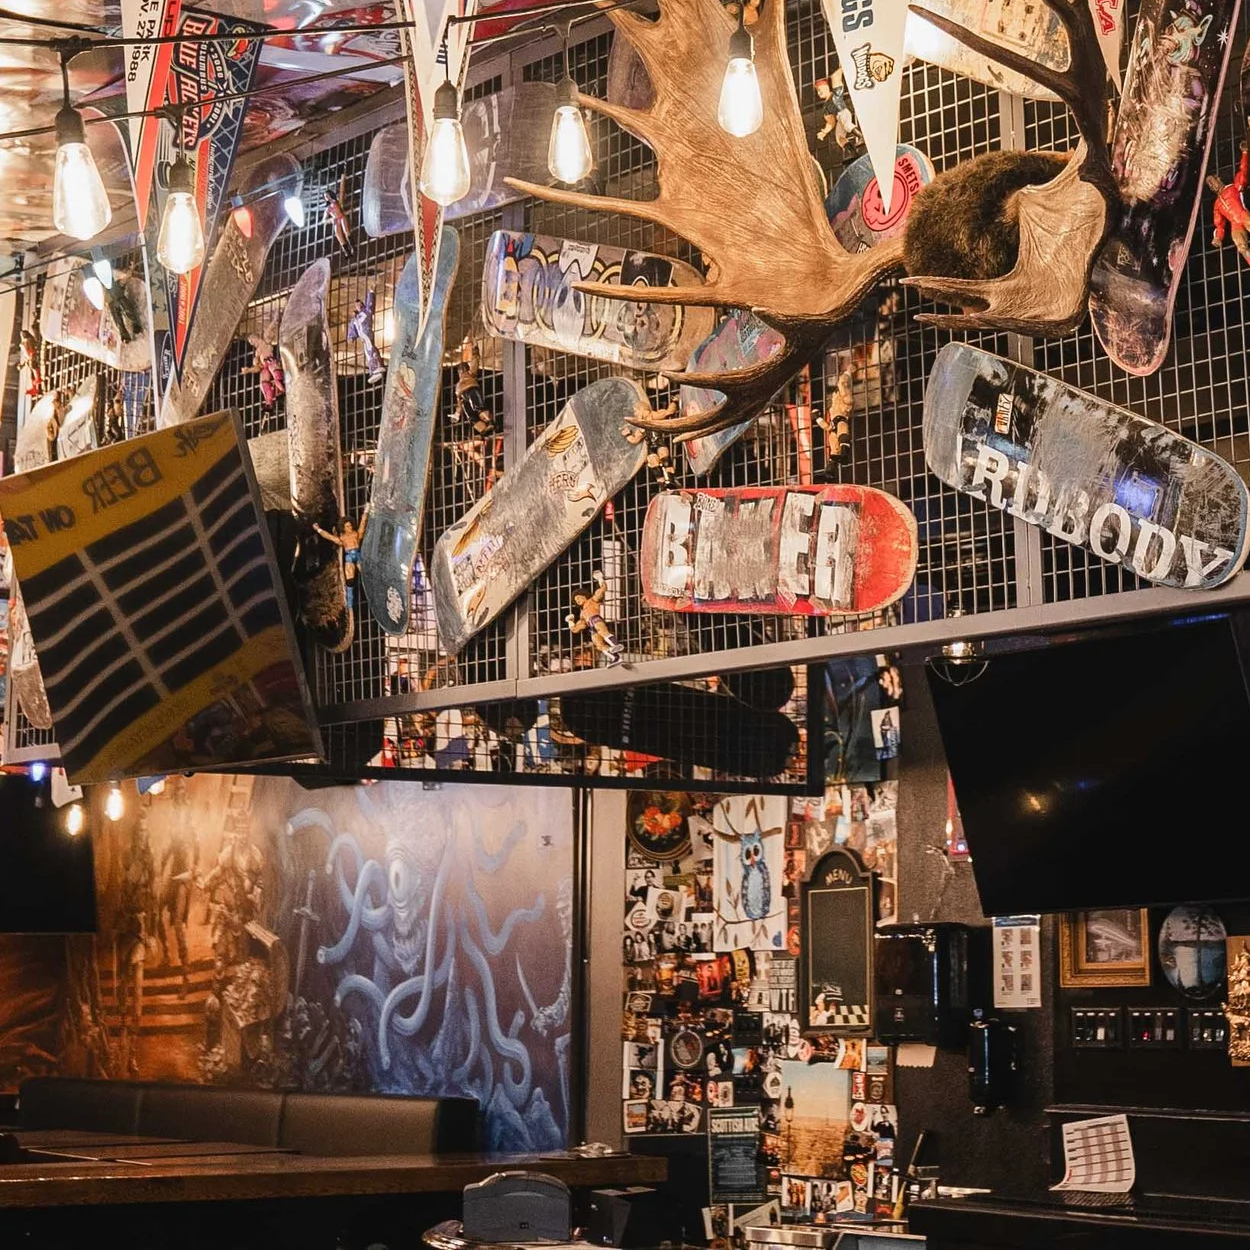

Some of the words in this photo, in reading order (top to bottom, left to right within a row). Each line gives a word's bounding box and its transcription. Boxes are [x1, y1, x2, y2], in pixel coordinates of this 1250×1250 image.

[174, 14, 207, 70] BUE
[210, 53, 225, 79] 2000
[824, 867, 853, 886] MENU
